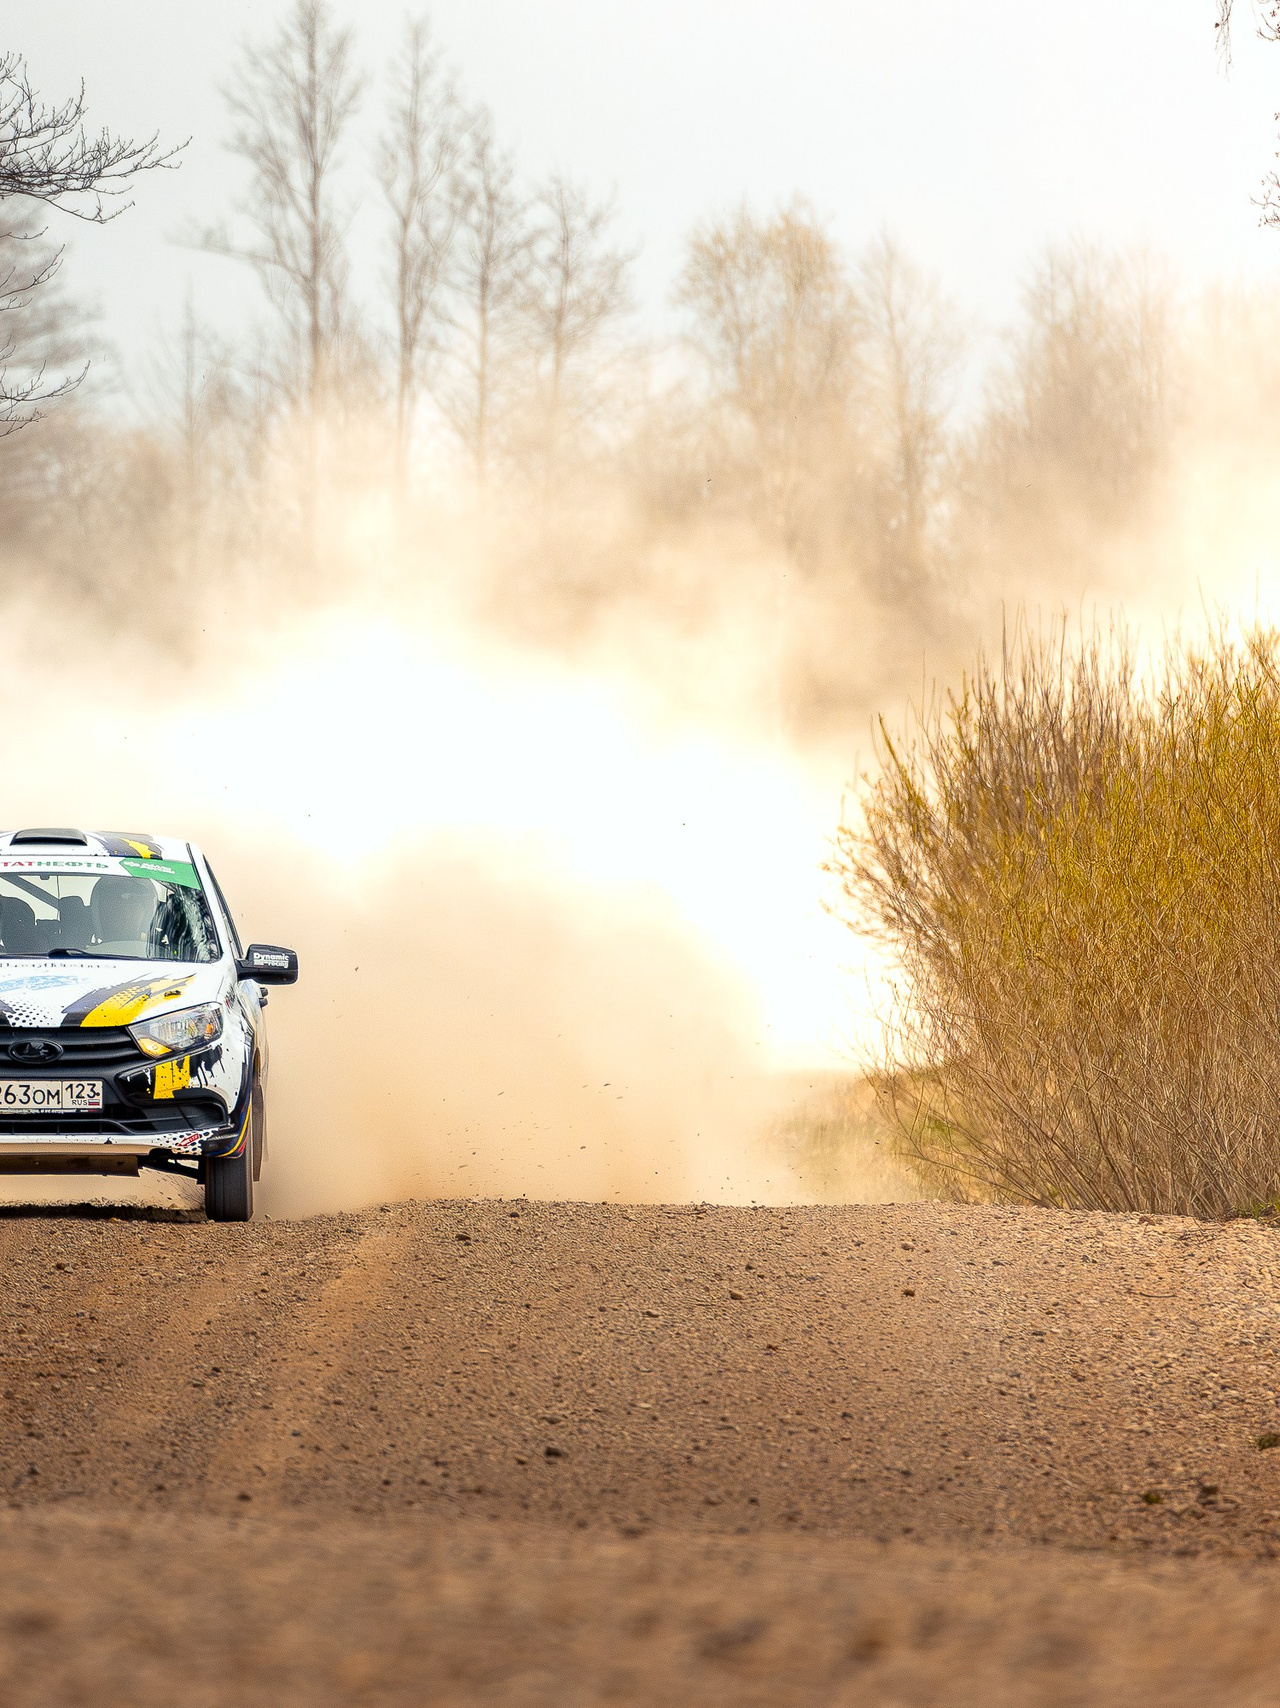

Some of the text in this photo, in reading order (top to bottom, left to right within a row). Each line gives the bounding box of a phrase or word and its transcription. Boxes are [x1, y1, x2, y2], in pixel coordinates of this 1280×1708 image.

[0, 860, 109, 869] ТАТНЕФТЬ
[253, 952, 289, 961] Dynamic
[65, 1083, 96, 1099] 123
